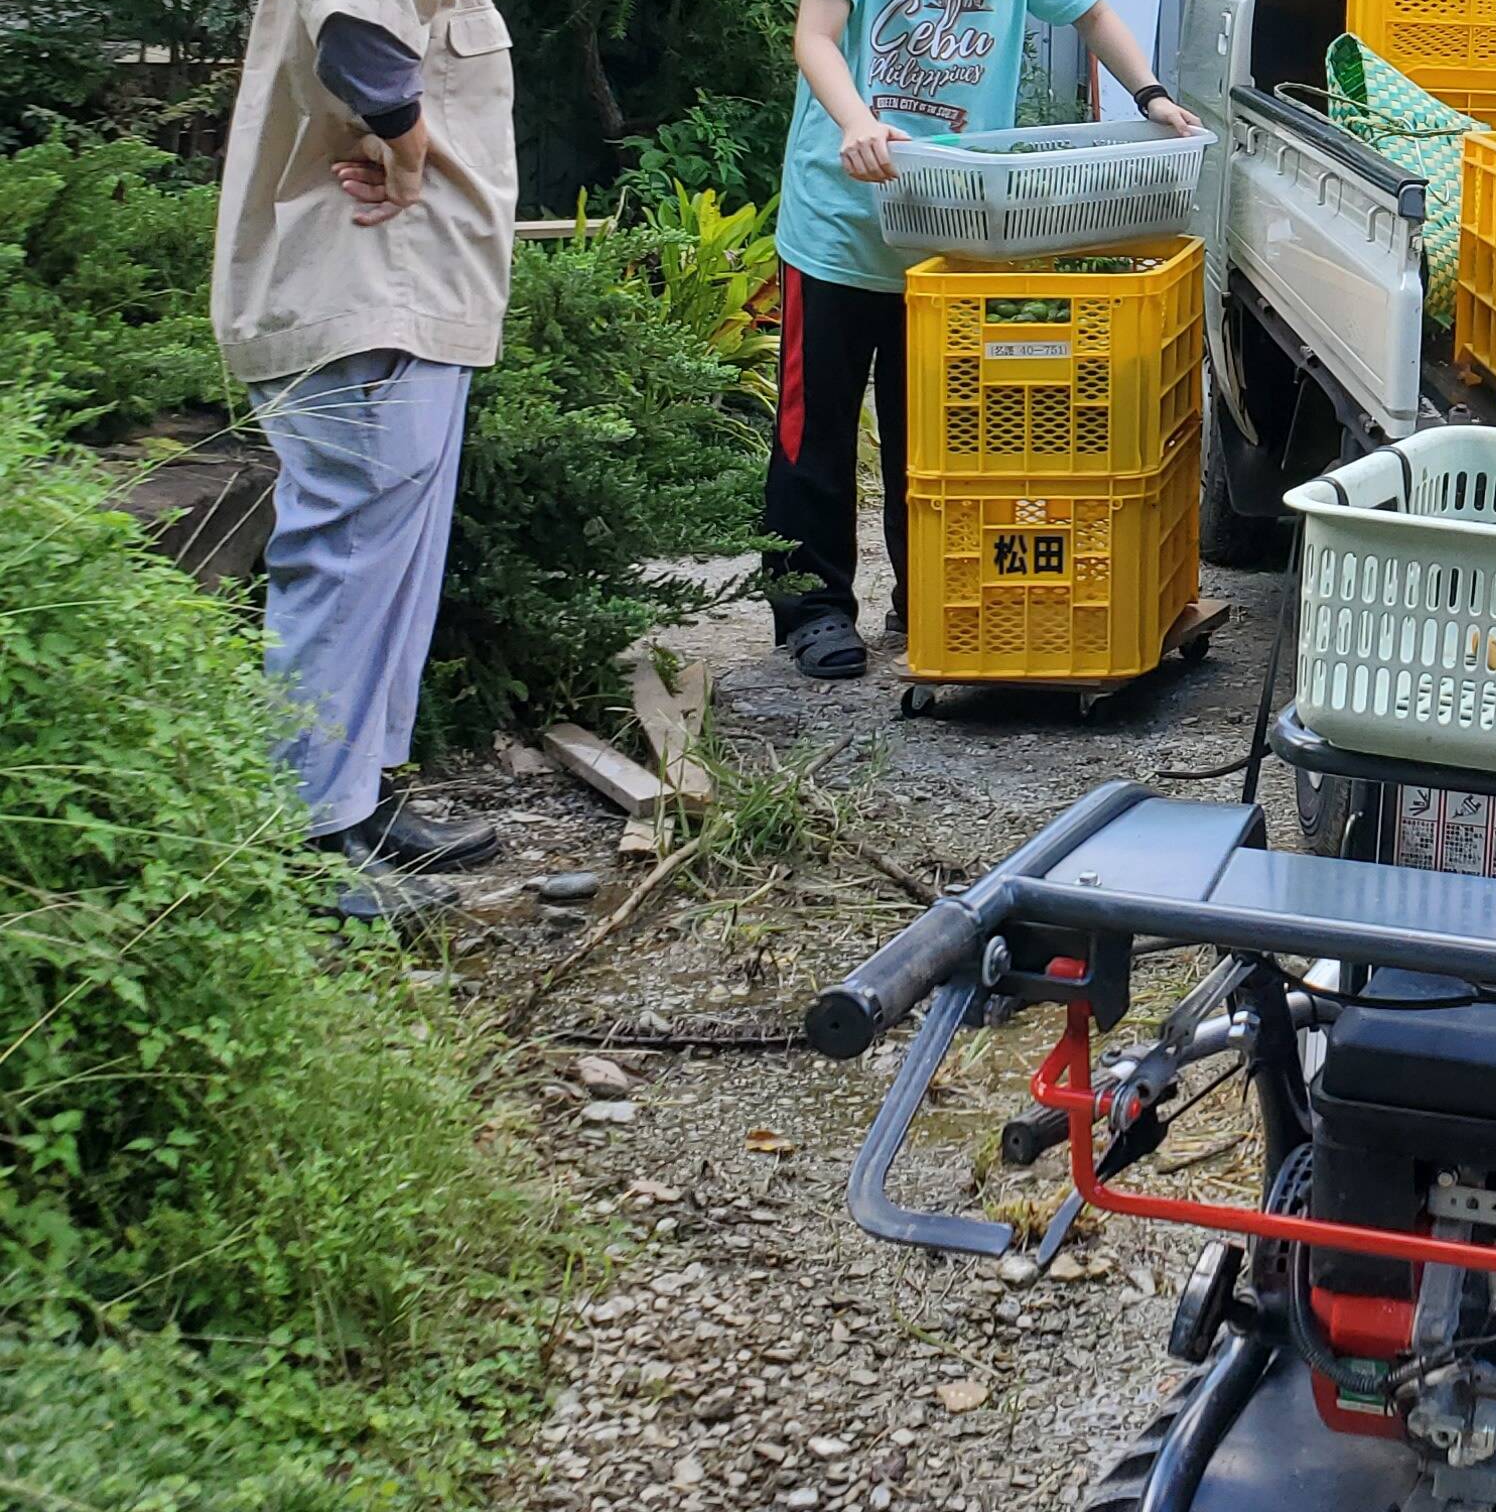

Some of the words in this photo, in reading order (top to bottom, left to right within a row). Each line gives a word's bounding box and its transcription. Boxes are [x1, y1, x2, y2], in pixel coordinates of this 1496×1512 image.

[868, 50, 985, 97] Philippines
[900, 99, 918, 111] CITY
[993, 534, 1064, 575] 松田
